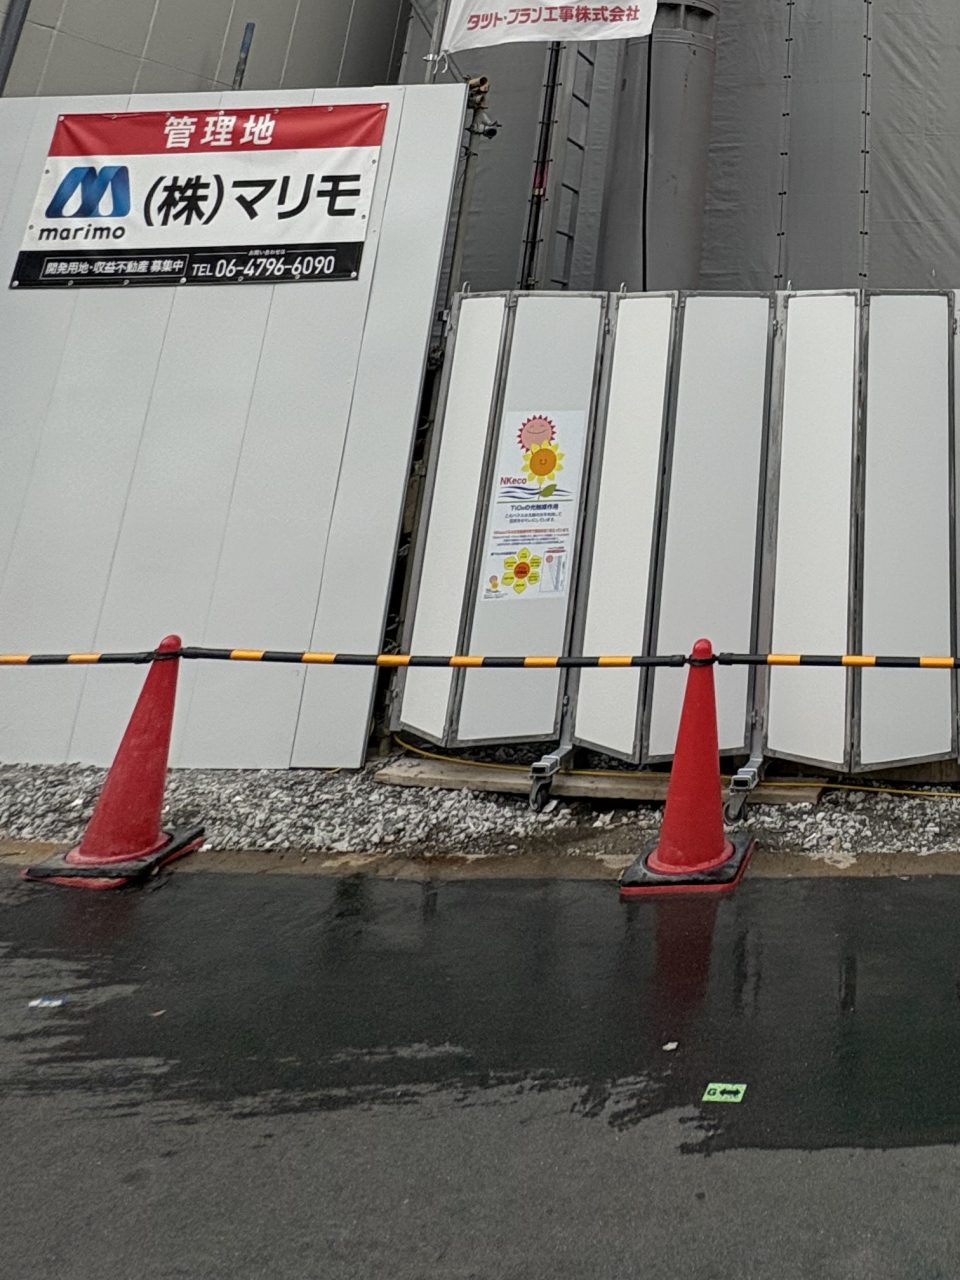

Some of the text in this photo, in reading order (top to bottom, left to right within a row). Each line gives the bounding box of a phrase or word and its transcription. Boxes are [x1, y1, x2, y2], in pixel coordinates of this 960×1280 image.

[163, 114, 277, 149] 管理地
[143, 173, 362, 226] (株)マリモ
[38, 223, 126, 241] marimo
[192, 255, 336, 278] TEL 06-4796-6090
[500, 476, 528, 486] NKeco
